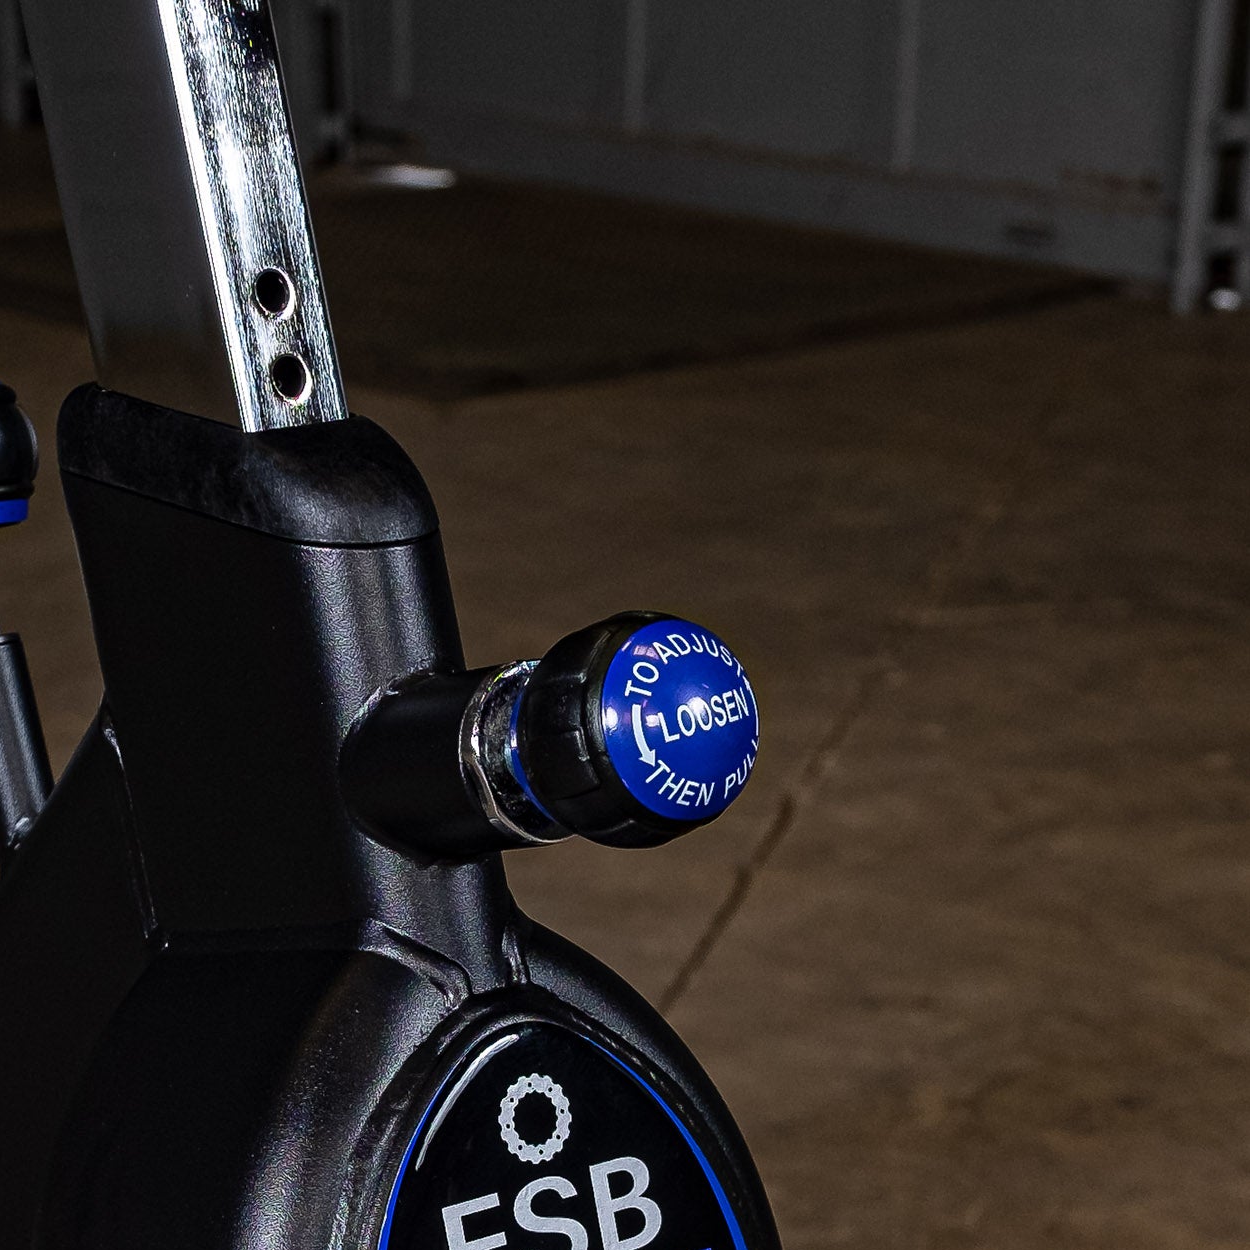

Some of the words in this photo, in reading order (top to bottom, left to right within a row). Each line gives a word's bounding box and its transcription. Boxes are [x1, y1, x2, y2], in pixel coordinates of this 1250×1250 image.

[624, 661, 659, 697] TO
[653, 632, 744, 678] ADJUST
[658, 686, 750, 743] LOOSEN
[645, 759, 715, 807] THEN
